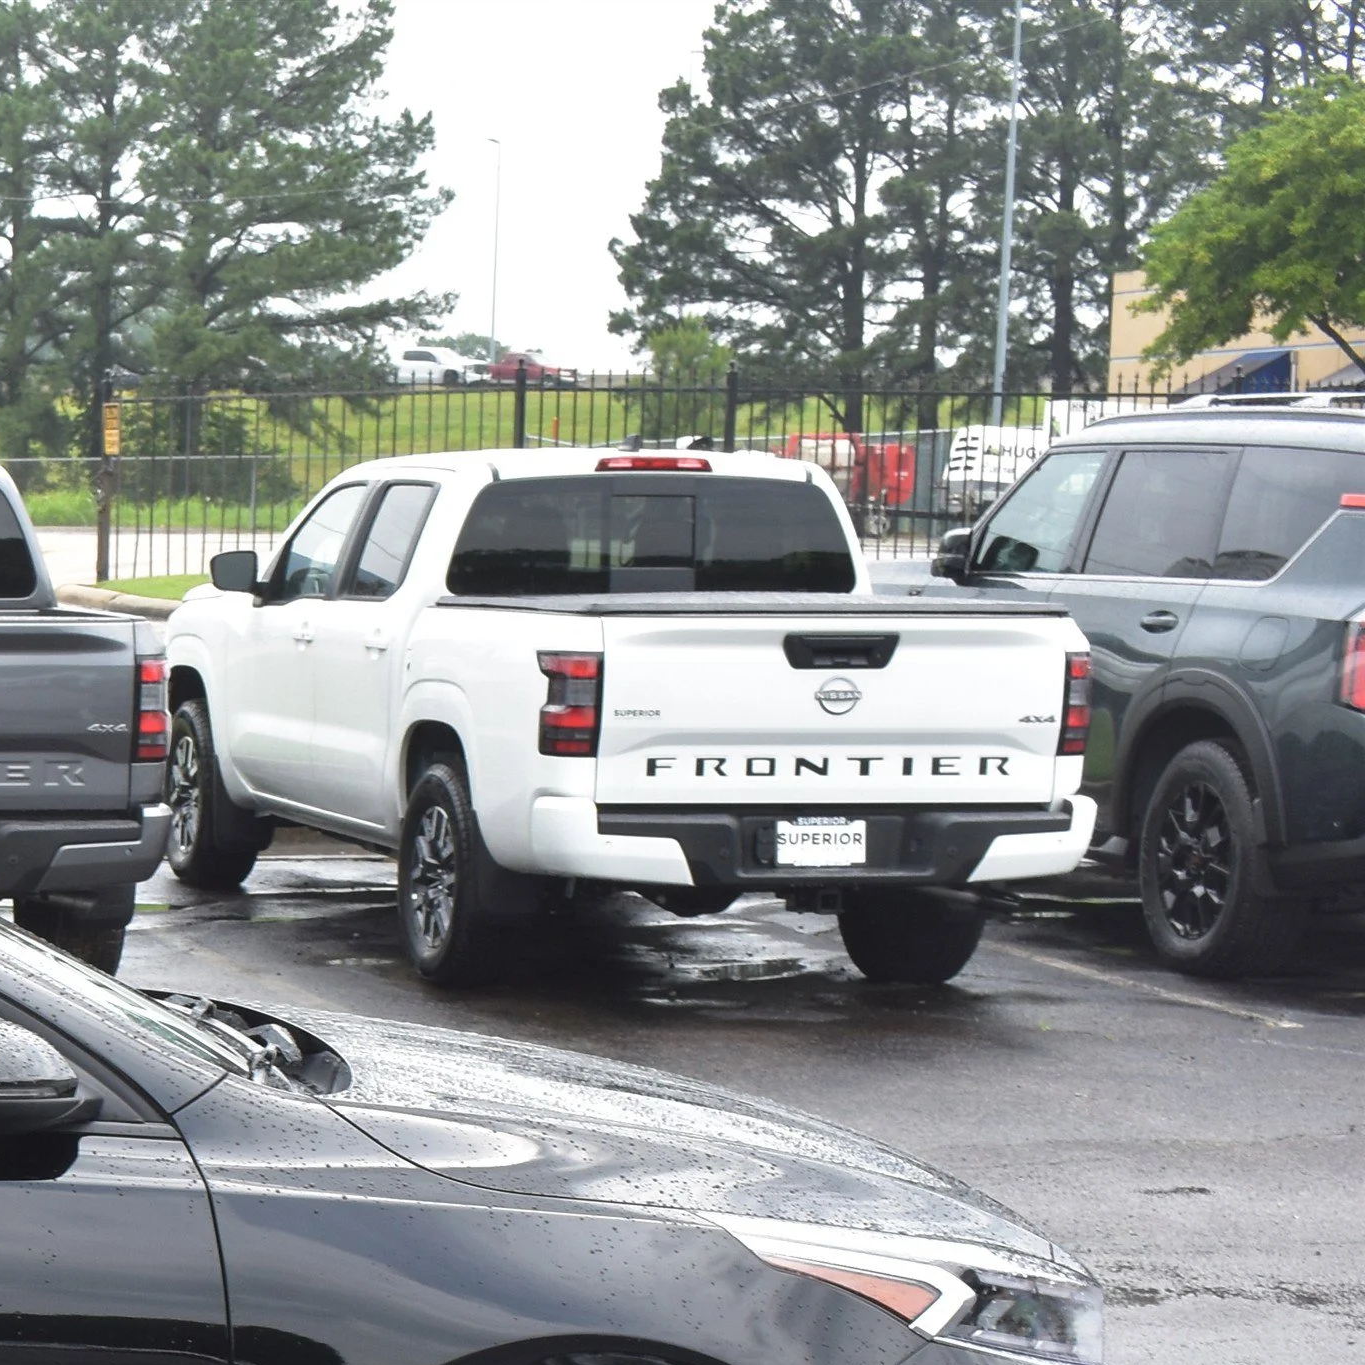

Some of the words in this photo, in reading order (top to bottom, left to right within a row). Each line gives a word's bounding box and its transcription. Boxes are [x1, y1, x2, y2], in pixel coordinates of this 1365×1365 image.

[1001, 445, 1041, 459] HUG
[814, 690, 862, 700] NISSAN
[613, 709, 661, 717] SUPERIOR
[645, 756, 1010, 777] FRONTIER
[797, 816, 846, 826] SUPERIOR
[777, 832, 863, 845] SUPERIOR
